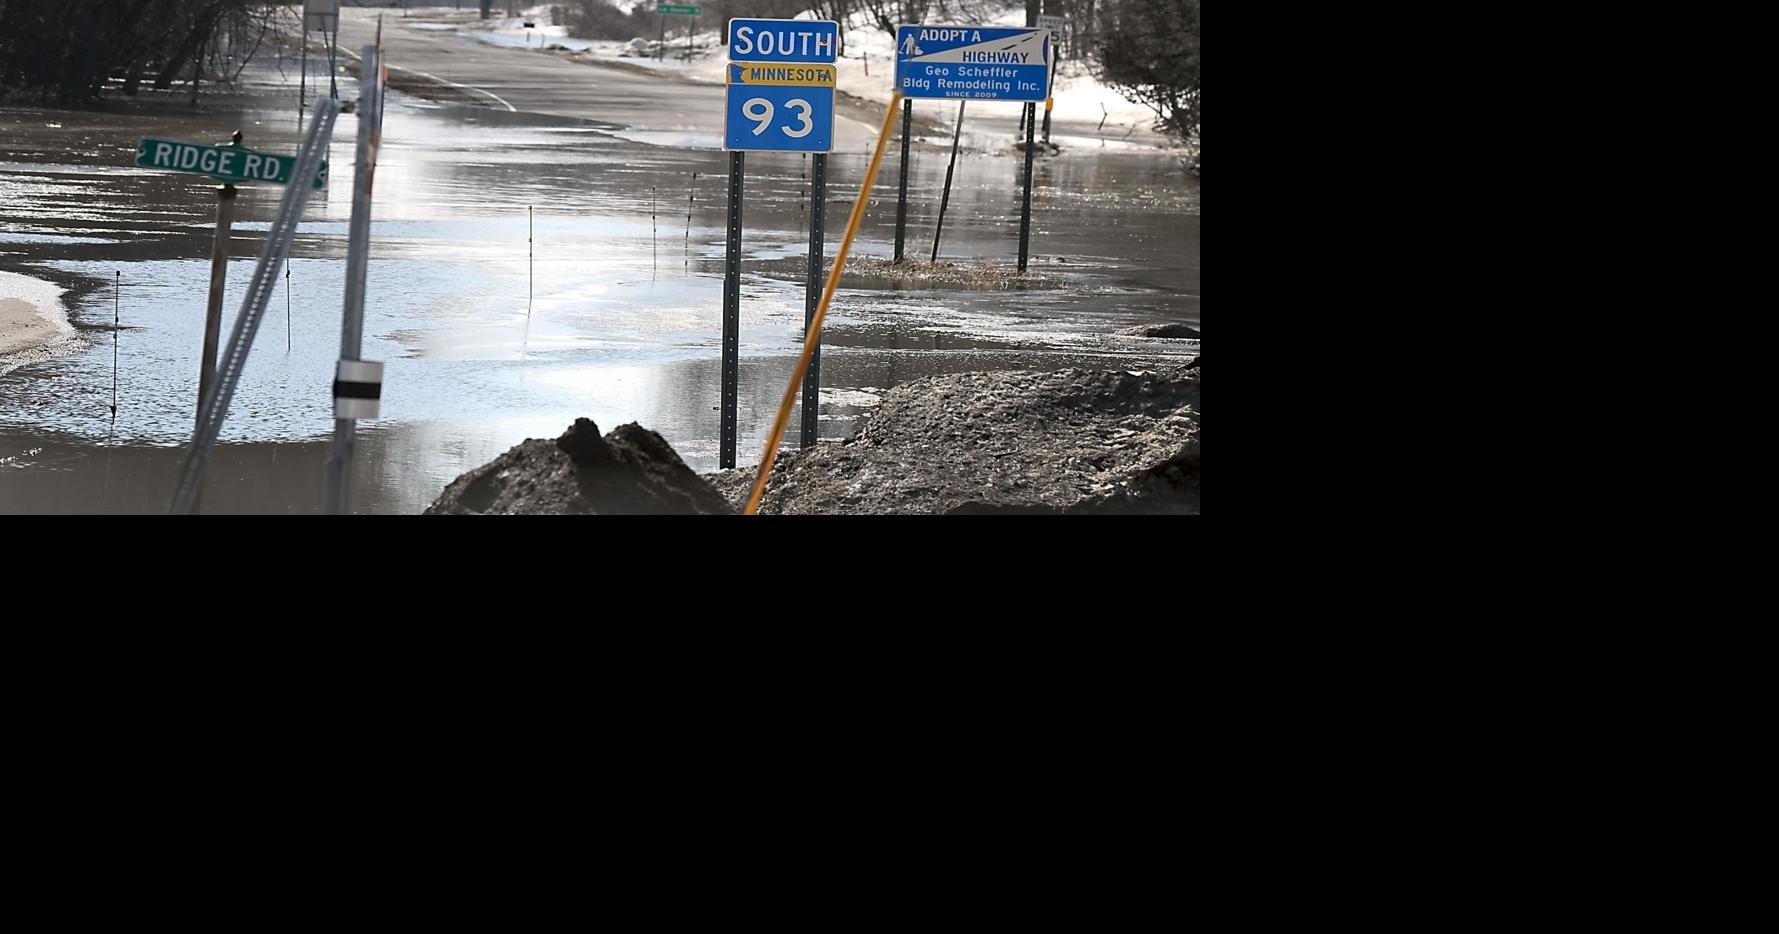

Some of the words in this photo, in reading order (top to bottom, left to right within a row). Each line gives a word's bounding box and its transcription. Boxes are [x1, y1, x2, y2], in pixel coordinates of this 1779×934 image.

[734, 26, 833, 57] SOUTH
[919, 29, 963, 42] ADOPT
[971, 30, 982, 42] A
[962, 50, 1030, 64] HIGHWAY
[750, 67, 833, 82] MINNESOTA
[925, 65, 949, 77] Geo
[958, 66, 1019, 78] Scheffler
[903, 77, 931, 91] Bldg
[937, 78, 1011, 92] Remodeling
[1018, 81, 1041, 92] Inc.
[741, 97, 814, 138] 93
[154, 142, 236, 175] RIDGE
[243, 154, 283, 181] RD.
